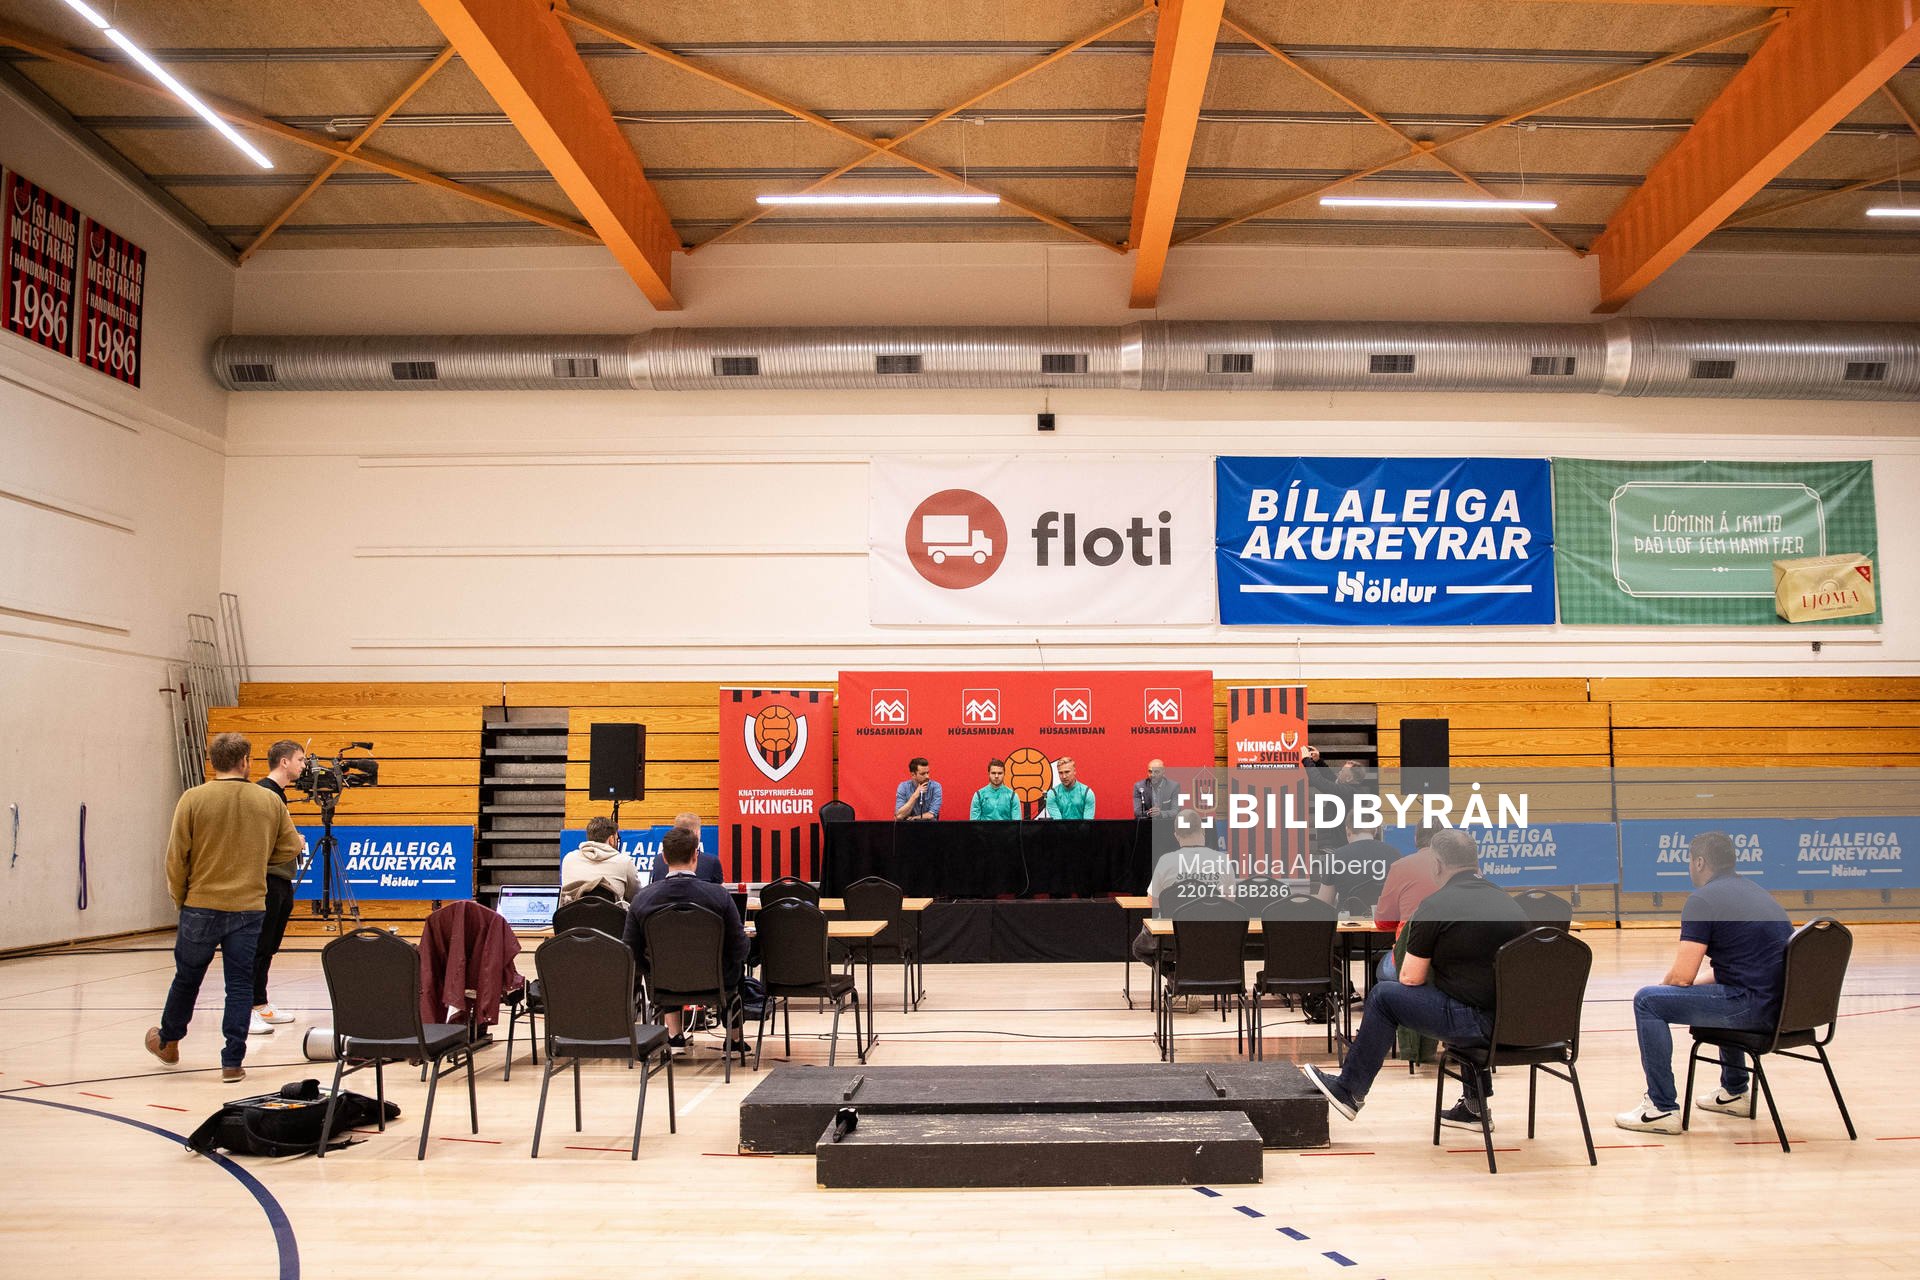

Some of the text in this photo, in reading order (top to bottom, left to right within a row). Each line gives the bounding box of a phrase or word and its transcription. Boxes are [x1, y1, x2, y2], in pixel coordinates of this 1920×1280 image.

[33, 198, 75, 246] ÍSLANDS
[11, 215, 74, 269] MEISTARAR
[14, 253, 71, 295] HANDKNATTLEIK
[109, 247, 142, 284] BIKAR
[88, 258, 141, 306] MEISTARAR
[11, 279, 68, 344] 1986
[90, 297, 139, 330] HANDKNATTLEIK
[87, 318, 136, 375] 1986
[1247, 480, 1521, 522] BÍLALEIGA
[1653, 510, 1714, 533] LJÓMINN
[1719, 510, 1733, 533] Á
[1031, 510, 1172, 566] floti
[1239, 526, 1532, 560] AKUREYRAR
[1634, 536, 1804, 554] ÞAÐ LOF SEM HANN FÆR
[1334, 571, 1437, 603] Höldur
[856, 727, 923, 736] HÚSASMIÐJAN
[947, 727, 1015, 736] HÚSASMIÐJAN
[1130, 725, 1197, 735] HÚSASMIÐJAN
[1236, 738, 1282, 752] VÍKINGA
[1260, 752, 1299, 762] SVEITIN
[738, 787, 814, 797] KNATTSPYRNUFÉLAGIÐ
[738, 797, 814, 814] VÍKINGUR
[1798, 830, 1899, 847] BÍLALEIGA
[348, 839, 453, 856] BÍLALEIGA
[1797, 846, 1902, 862] AKUREYRAR
[345, 856, 457, 871] AKUREYRAR
[1483, 861, 1522, 875] Höldur
[1831, 864, 1869, 877] Höldur
[380, 873, 419, 887] Höldur
